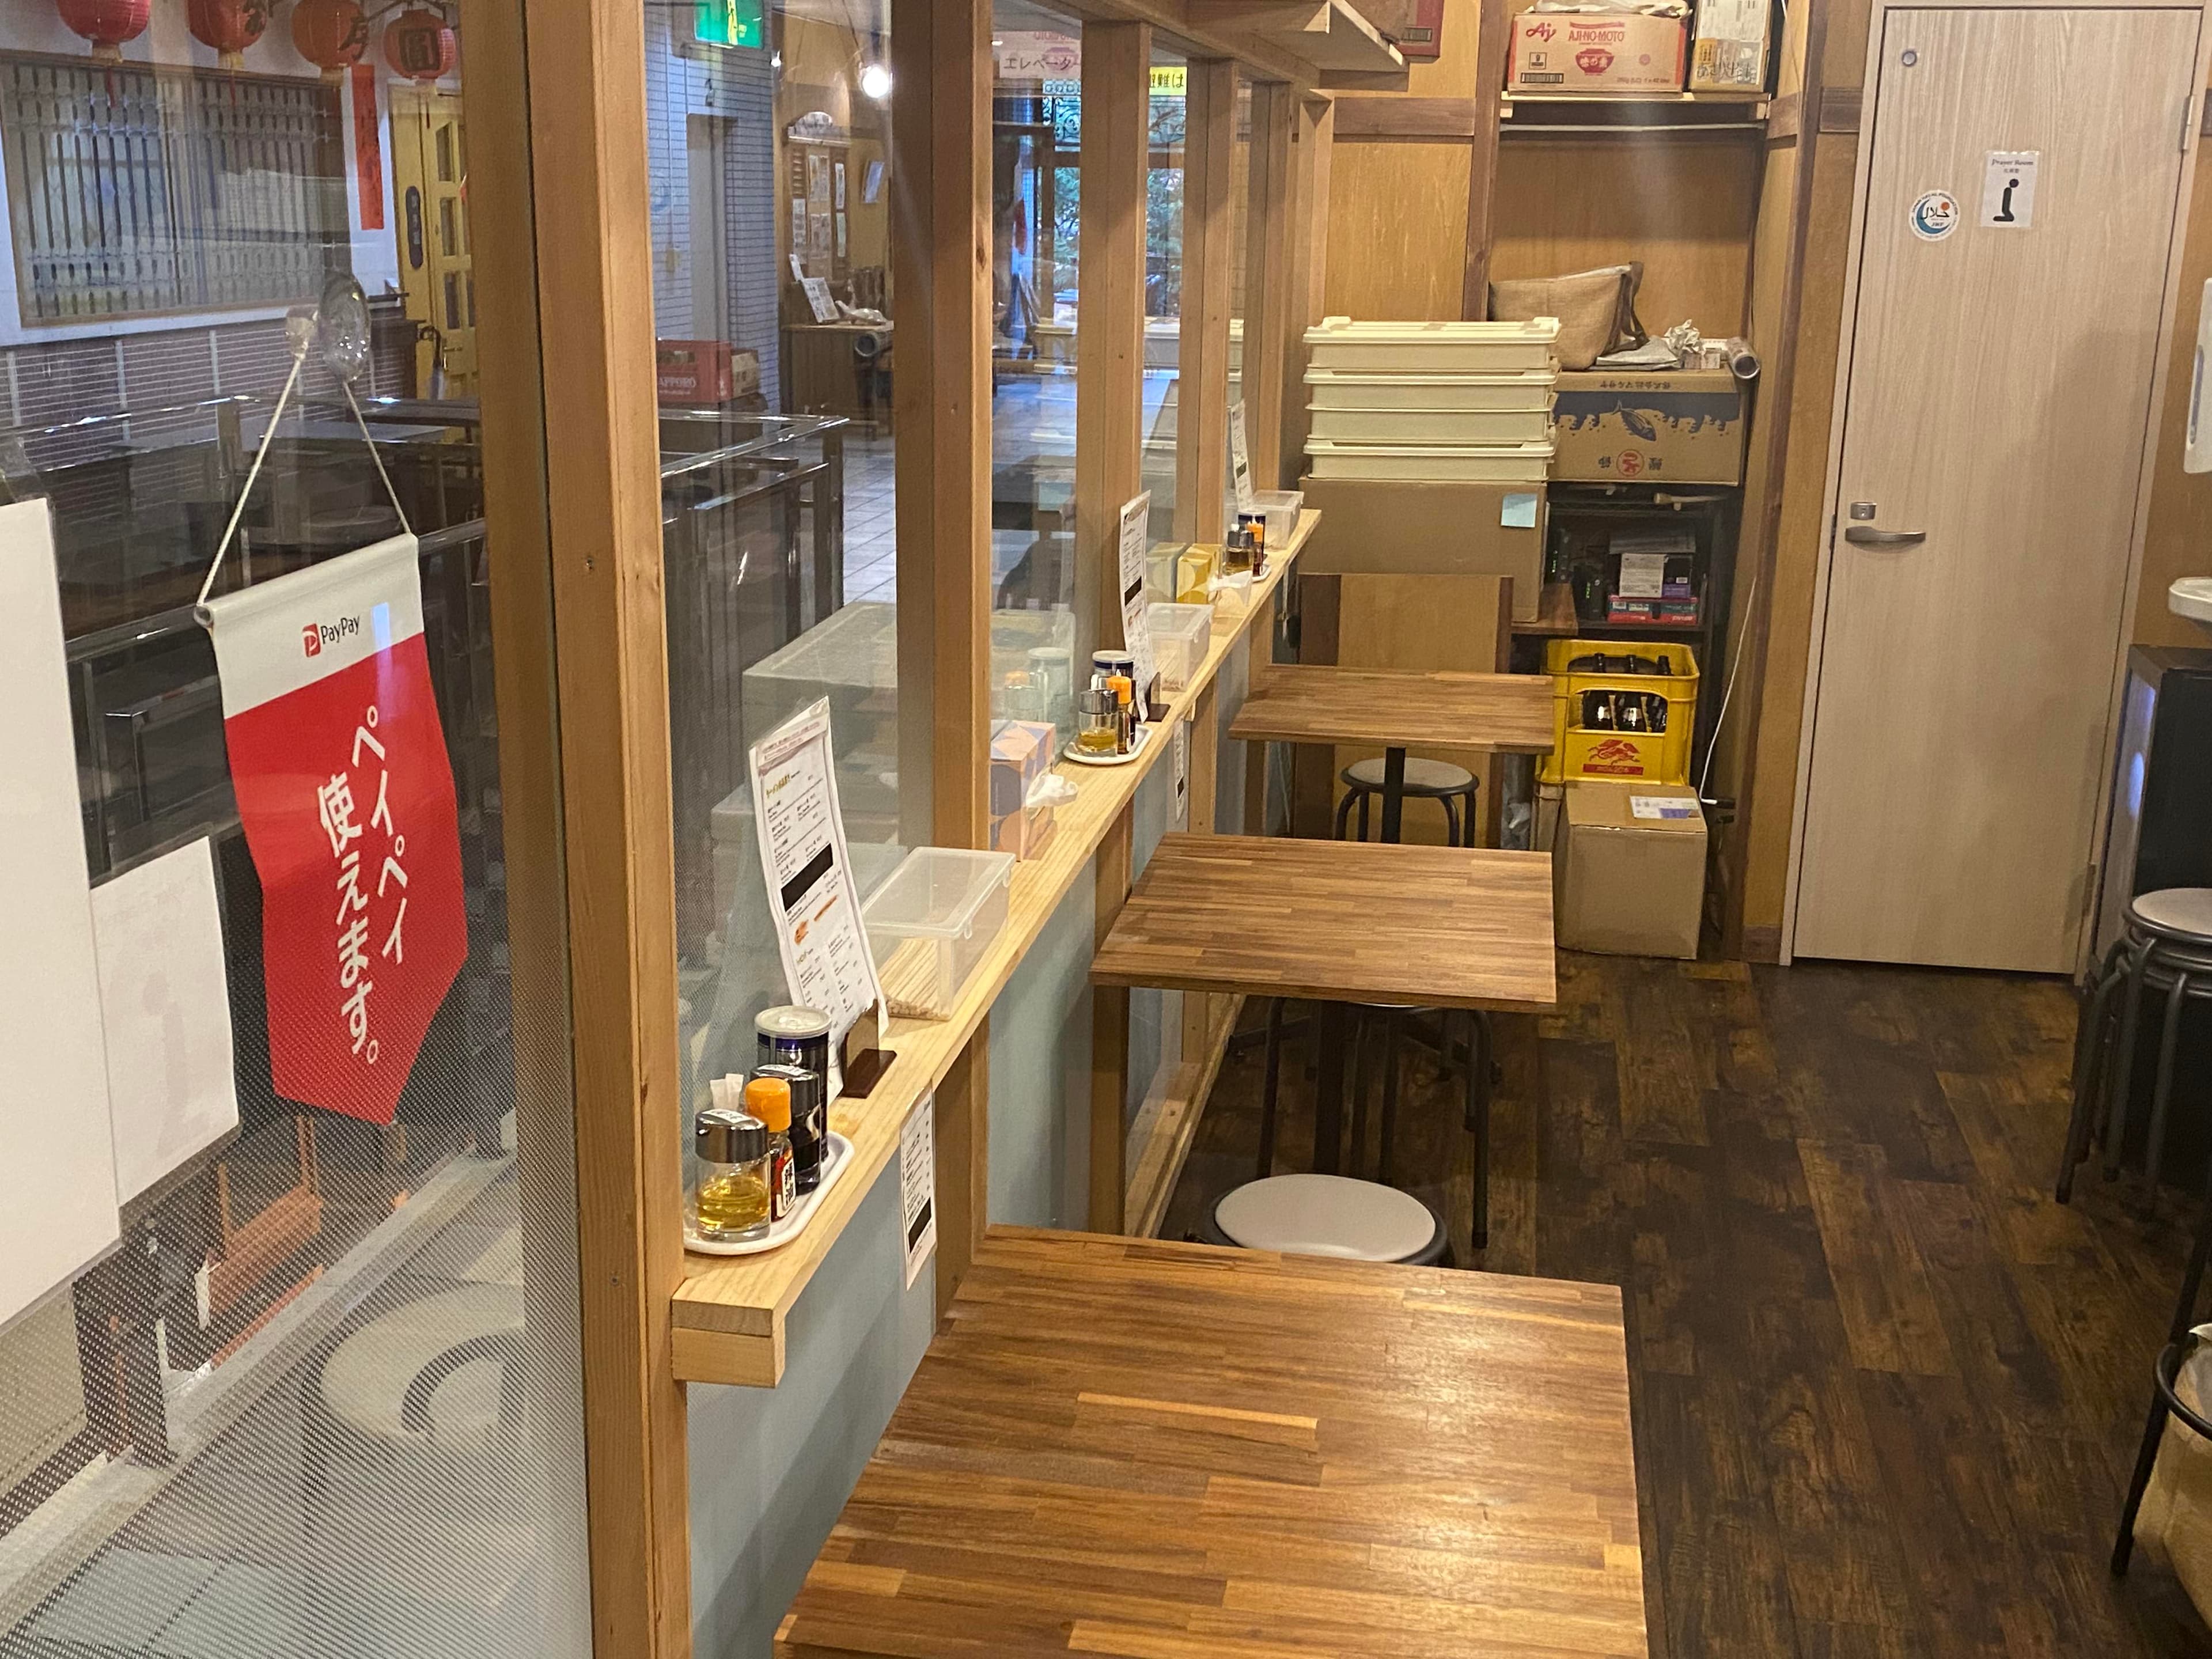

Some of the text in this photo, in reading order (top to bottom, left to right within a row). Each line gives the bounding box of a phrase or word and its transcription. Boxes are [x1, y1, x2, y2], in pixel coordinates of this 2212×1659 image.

[320, 615, 359, 645] PayPay
[317, 771, 378, 1065] 使えます。
[351, 705, 408, 965] ペイペイ
